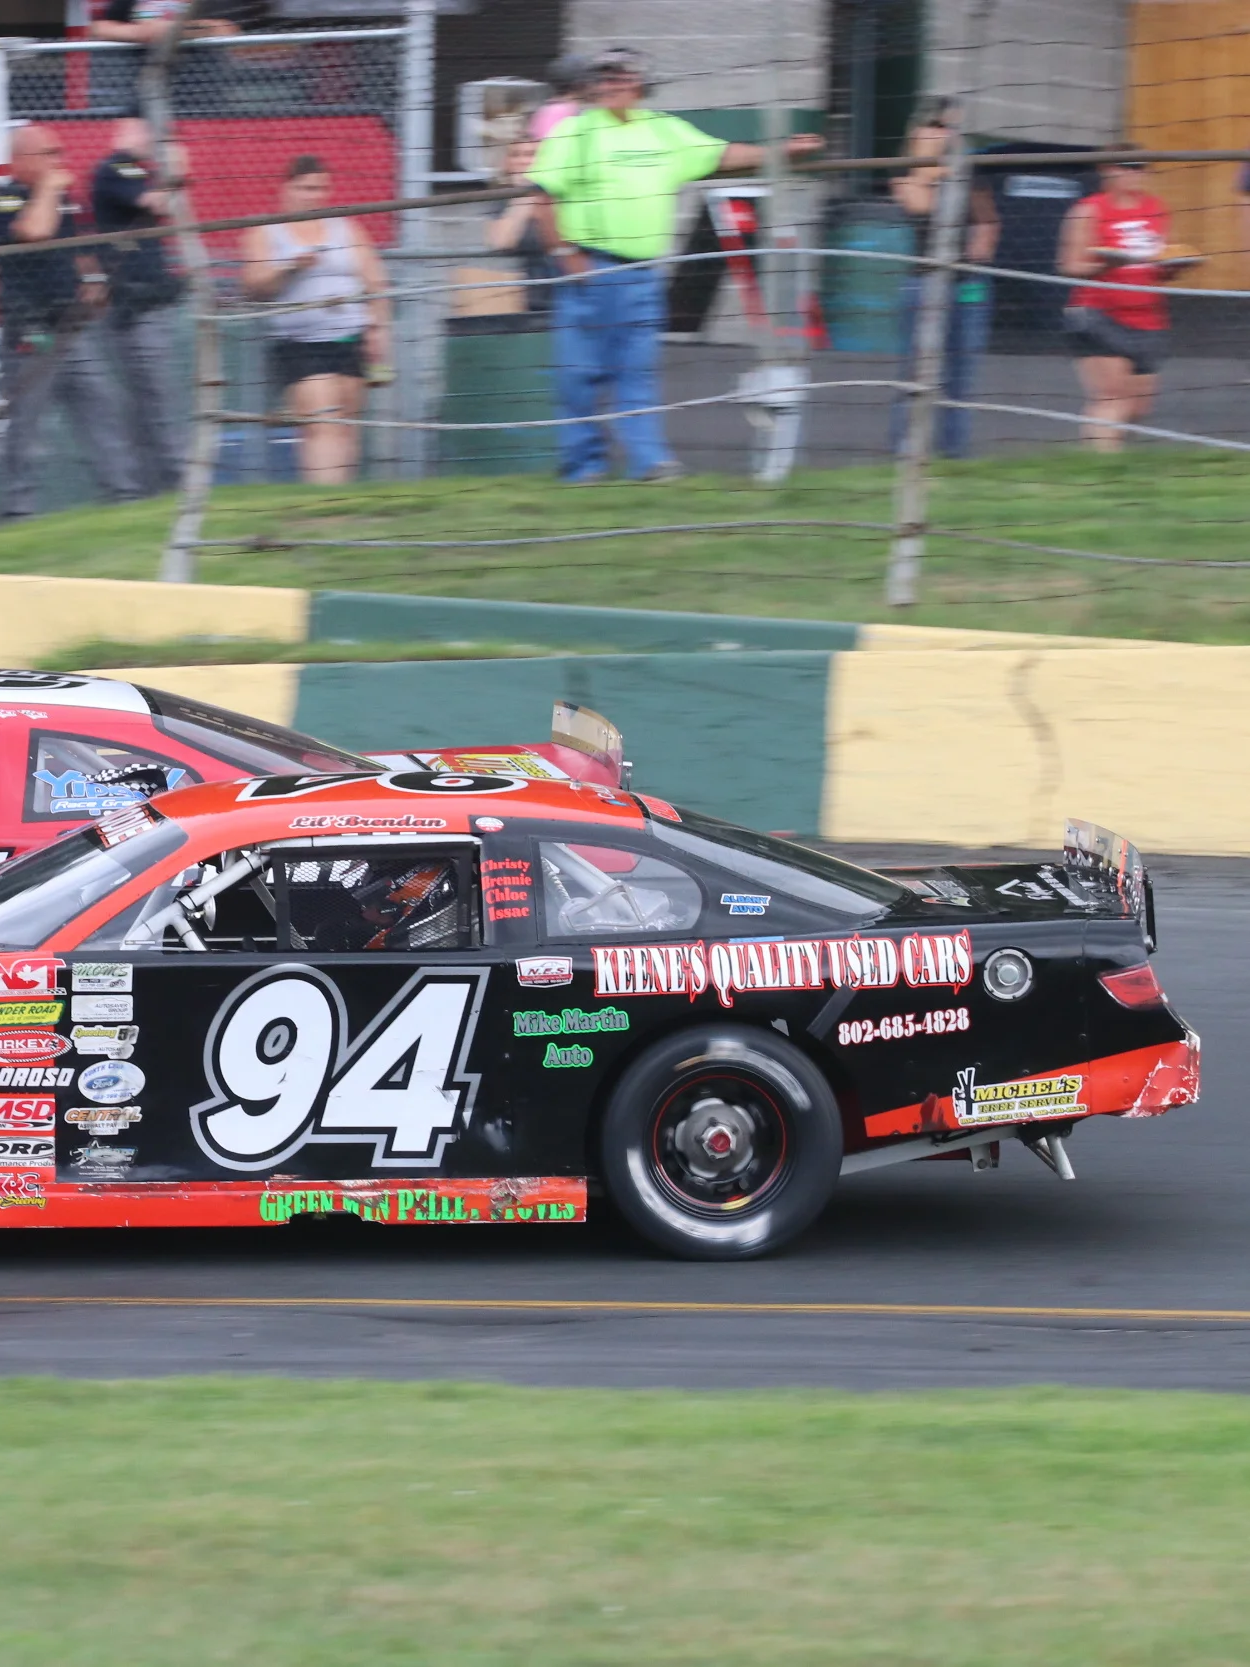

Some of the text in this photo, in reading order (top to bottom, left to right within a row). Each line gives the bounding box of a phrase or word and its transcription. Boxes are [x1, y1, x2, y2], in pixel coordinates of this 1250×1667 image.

[55, 800, 97, 809] Race
[335, 814, 446, 828] Brendan
[481, 858, 530, 873] Christy
[481, 873, 532, 890] Brennie
[486, 889, 527, 904] Chloe
[723, 895, 768, 904] ALBANY
[732, 905, 763, 913] AUTO
[591, 931, 973, 1006] KEENE'S QUALITY USED CARS
[28, 1005, 57, 1014] ROAD
[514, 1007, 629, 1036] Mike Martin
[838, 1008, 970, 1046] 802-685-4828
[543, 1043, 593, 1067] Auto
[191, 964, 489, 1170] 94
[974, 1076, 1081, 1101] MICHEL'S
[978, 1095, 1075, 1114] TREE SERVICE
[260, 1190, 333, 1222] GREEN
